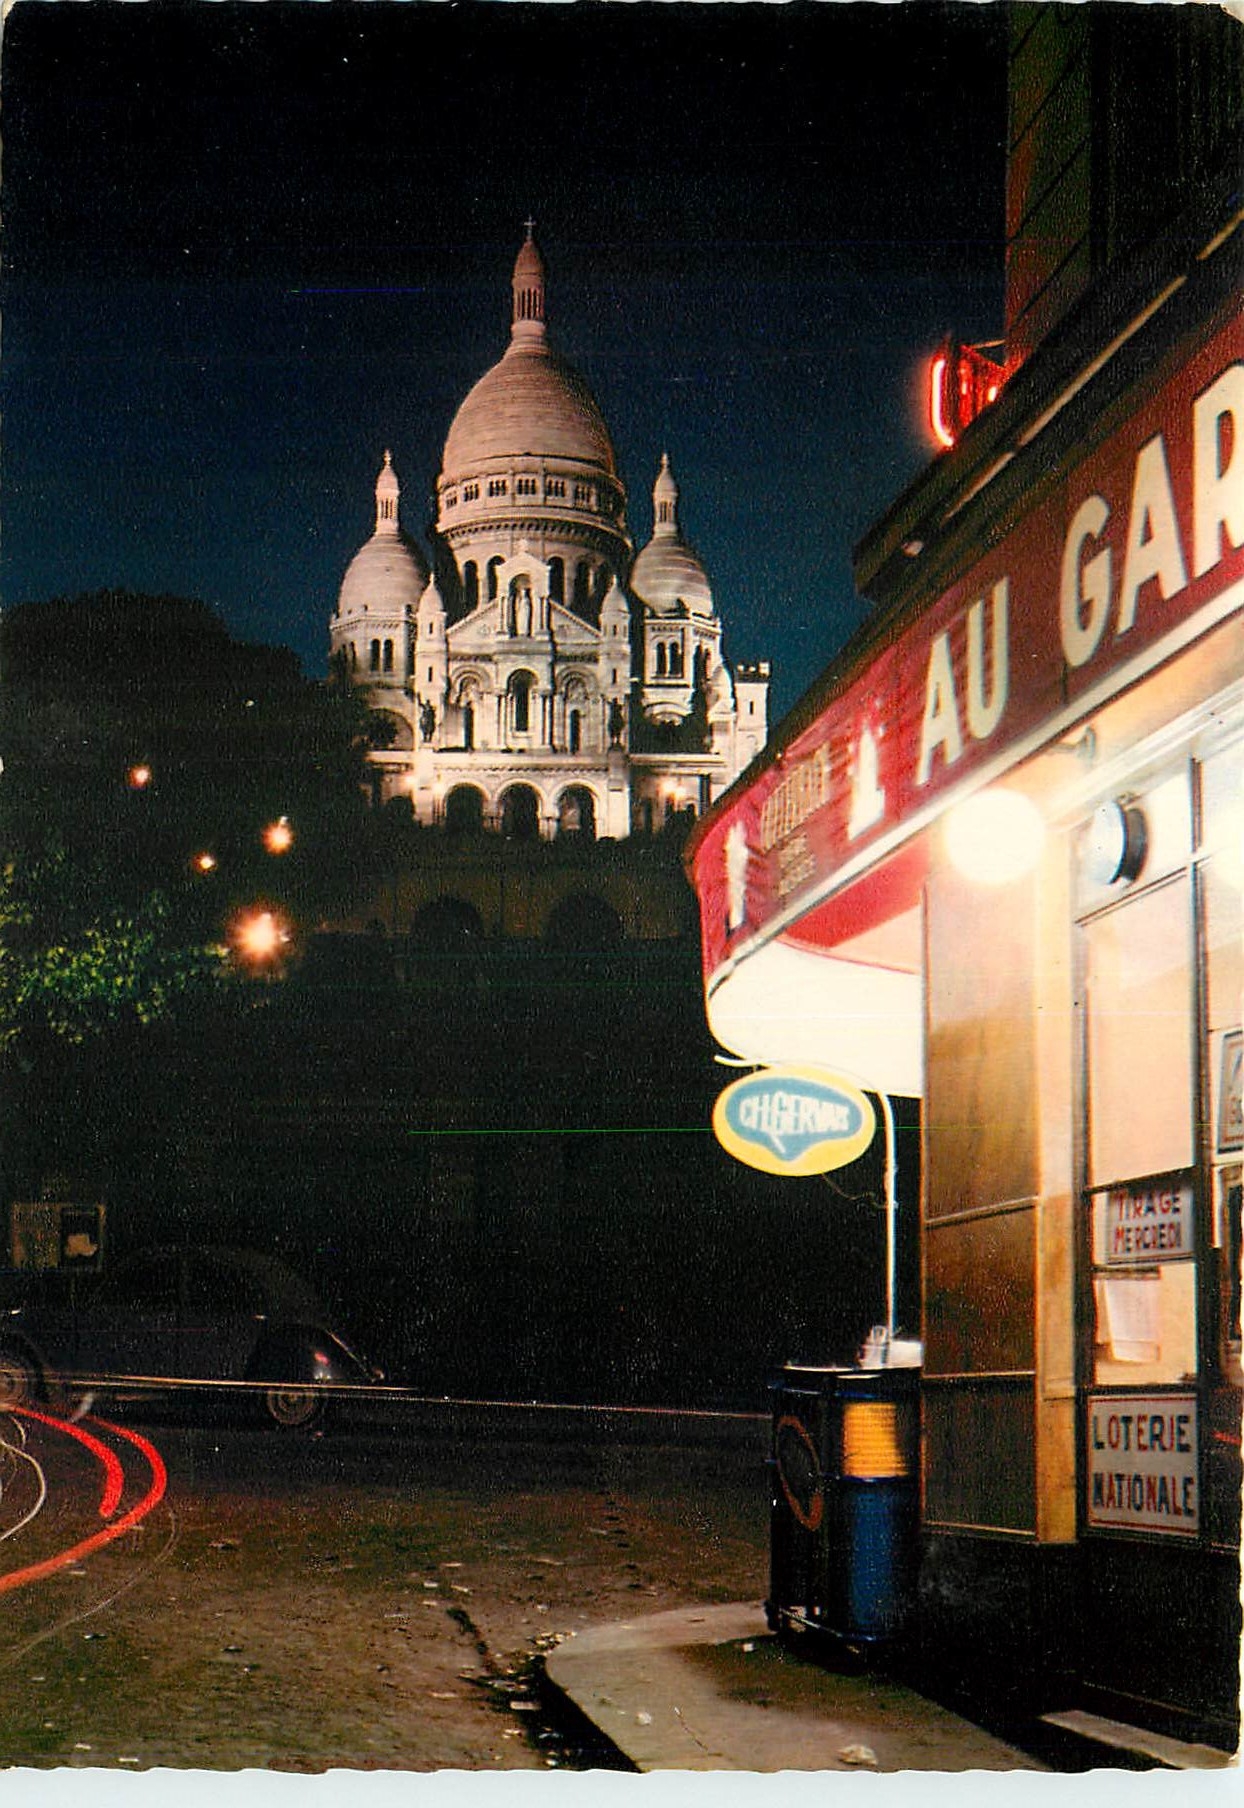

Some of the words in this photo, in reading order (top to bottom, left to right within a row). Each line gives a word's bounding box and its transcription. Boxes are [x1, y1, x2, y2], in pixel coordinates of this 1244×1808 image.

[917, 577, 1010, 787] AU
[1060, 365, 1244, 668] GAR
[1112, 1188, 1181, 1221] TIRAGE
[1093, 1415, 1192, 1452] LOTERIE
[1093, 1472, 1196, 1518] NATIONALE
